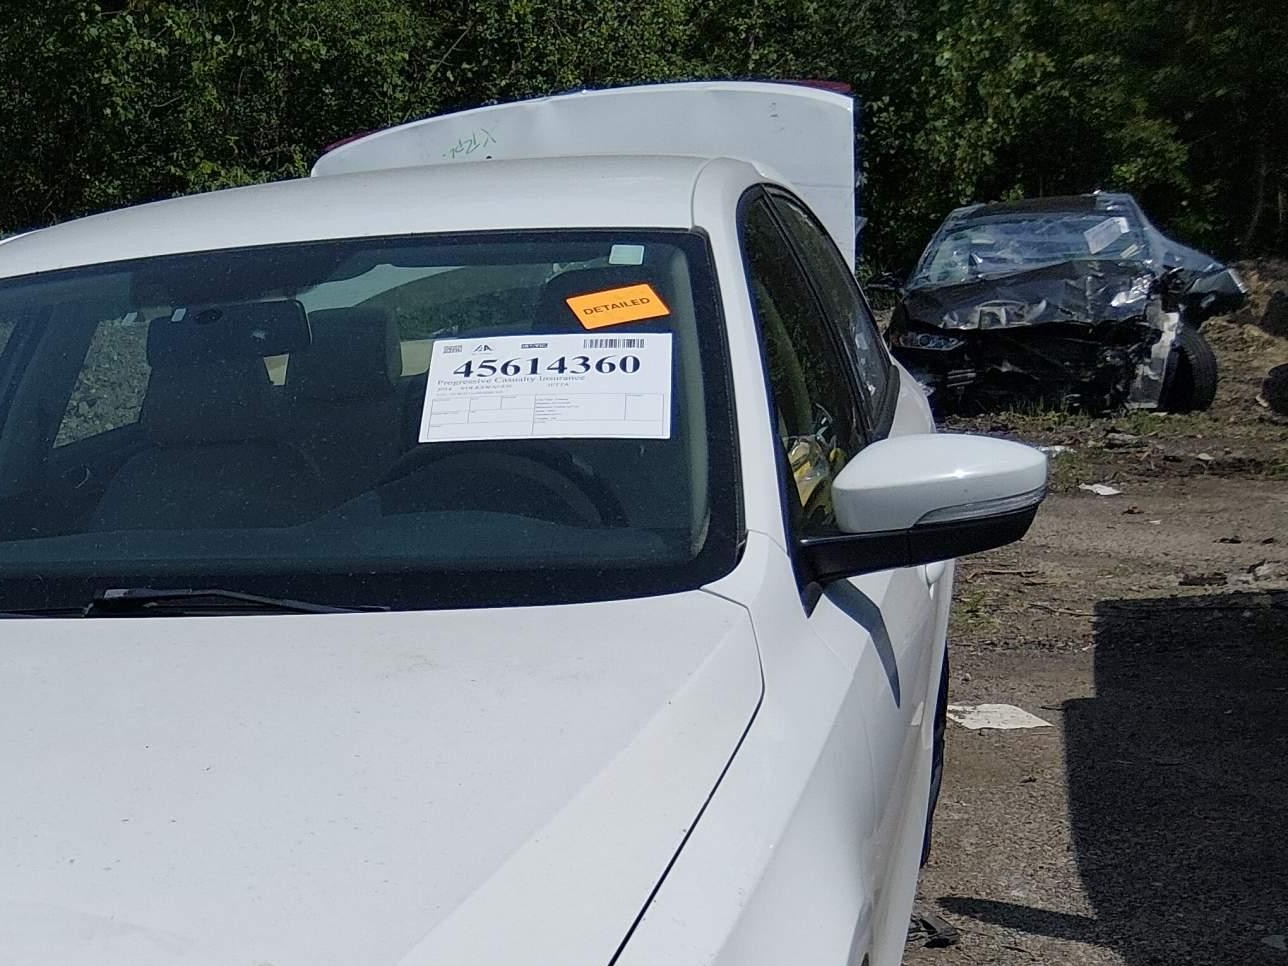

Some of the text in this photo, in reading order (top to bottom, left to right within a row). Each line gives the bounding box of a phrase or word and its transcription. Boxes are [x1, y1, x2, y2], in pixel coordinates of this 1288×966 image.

[583, 296, 650, 316] DETAILED
[453, 355, 641, 378] 45614360
[437, 378, 492, 386] Progressive
